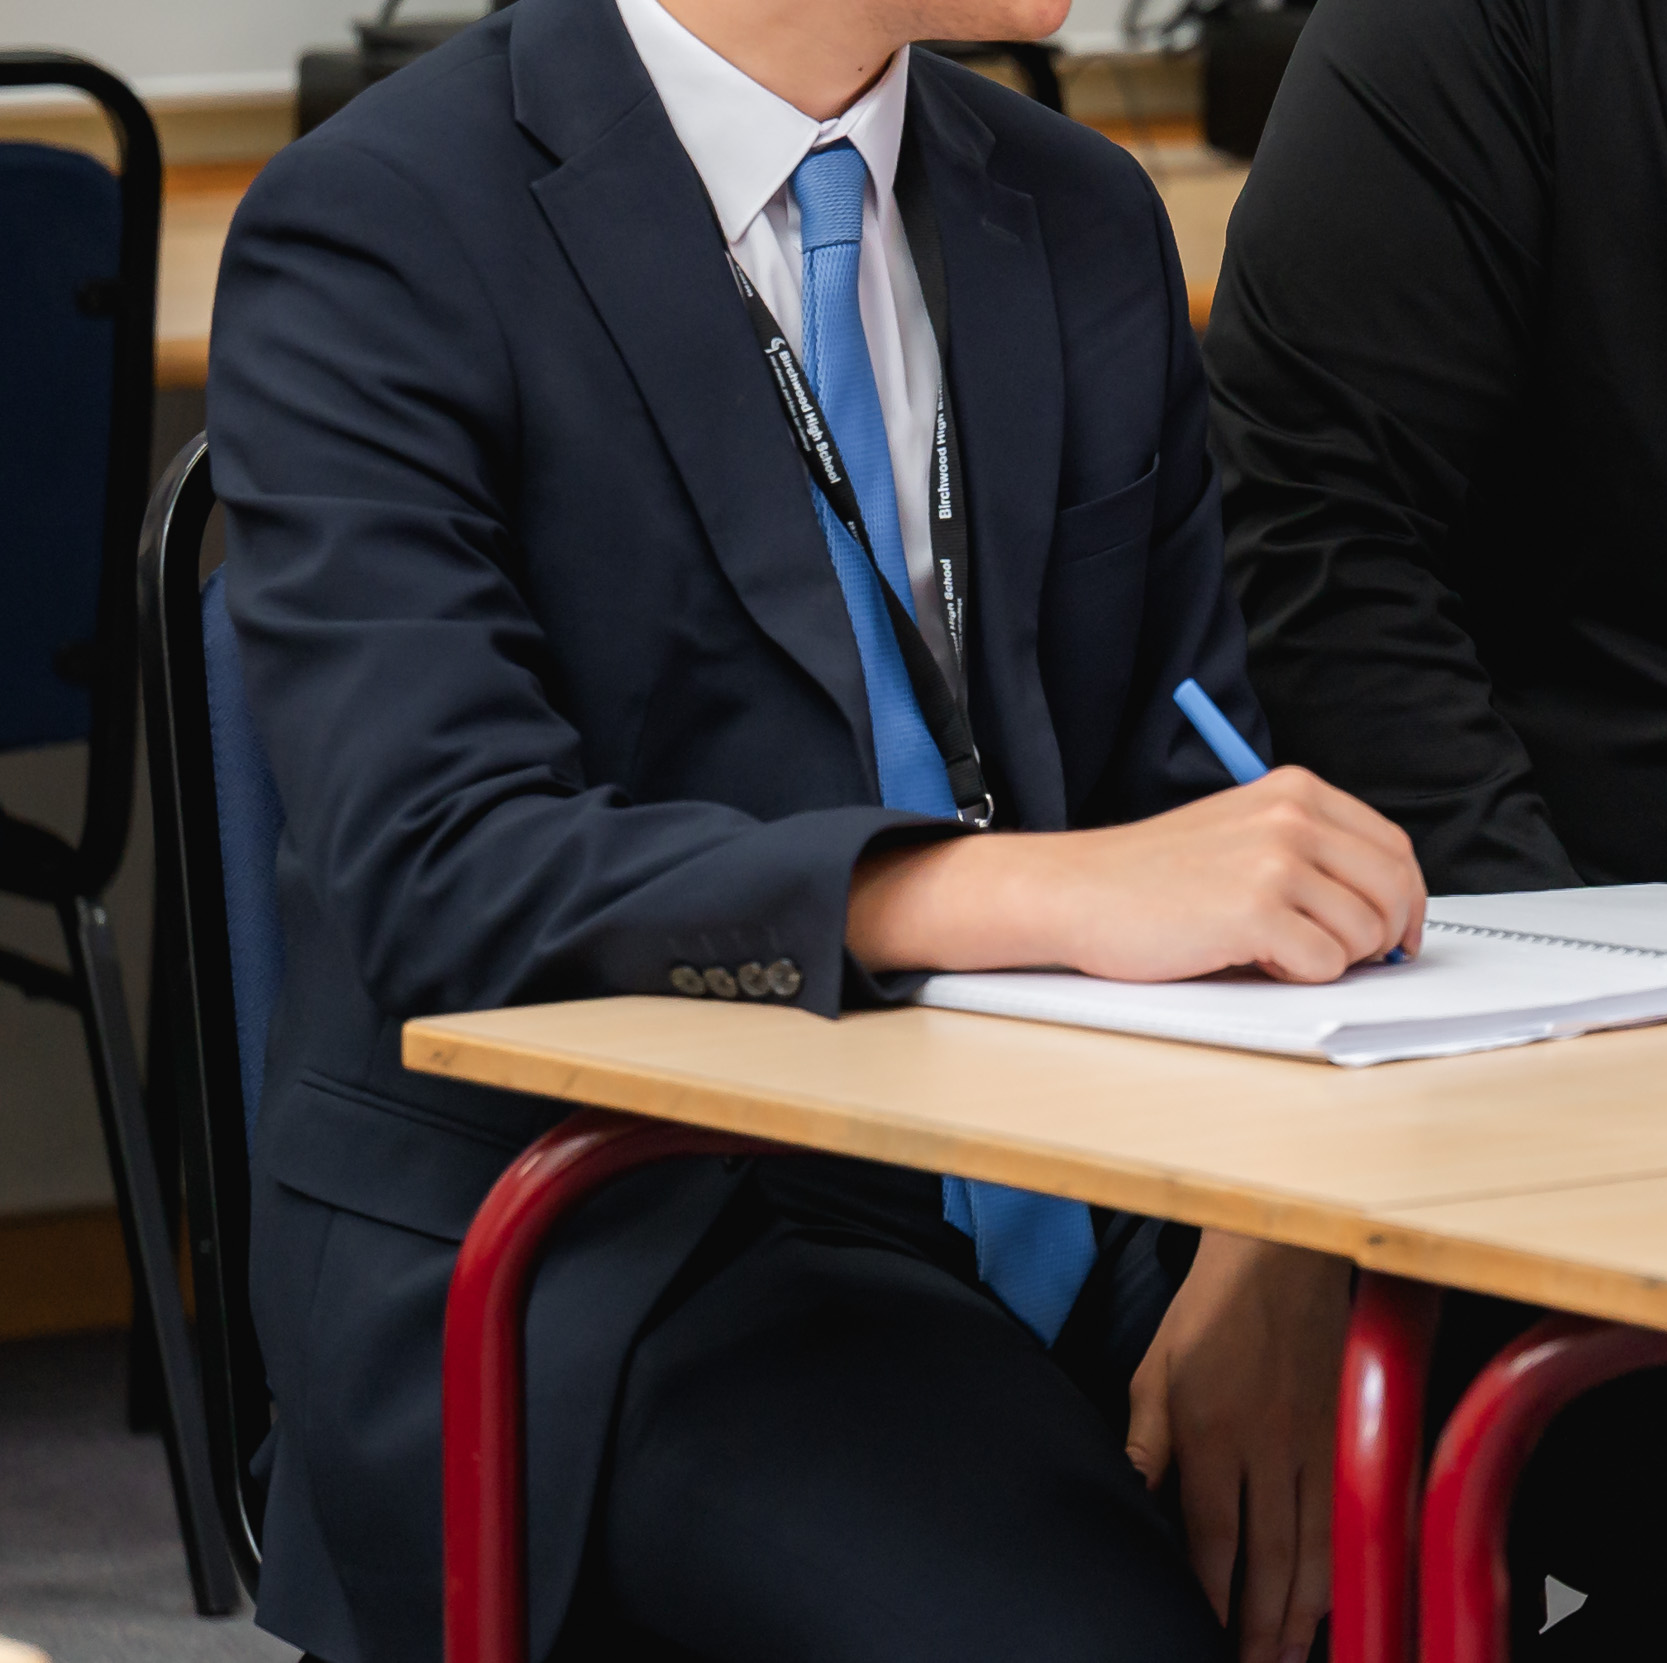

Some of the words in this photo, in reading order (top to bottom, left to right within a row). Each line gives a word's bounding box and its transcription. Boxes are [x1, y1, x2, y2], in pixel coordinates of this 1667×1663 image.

[779, 350, 813, 413] Birchwood
[805, 412, 823, 442] High
[815, 442, 842, 484] School
[937, 413, 947, 445] High
[938, 445, 952, 519] Birchwood
[941, 558, 954, 601] School
